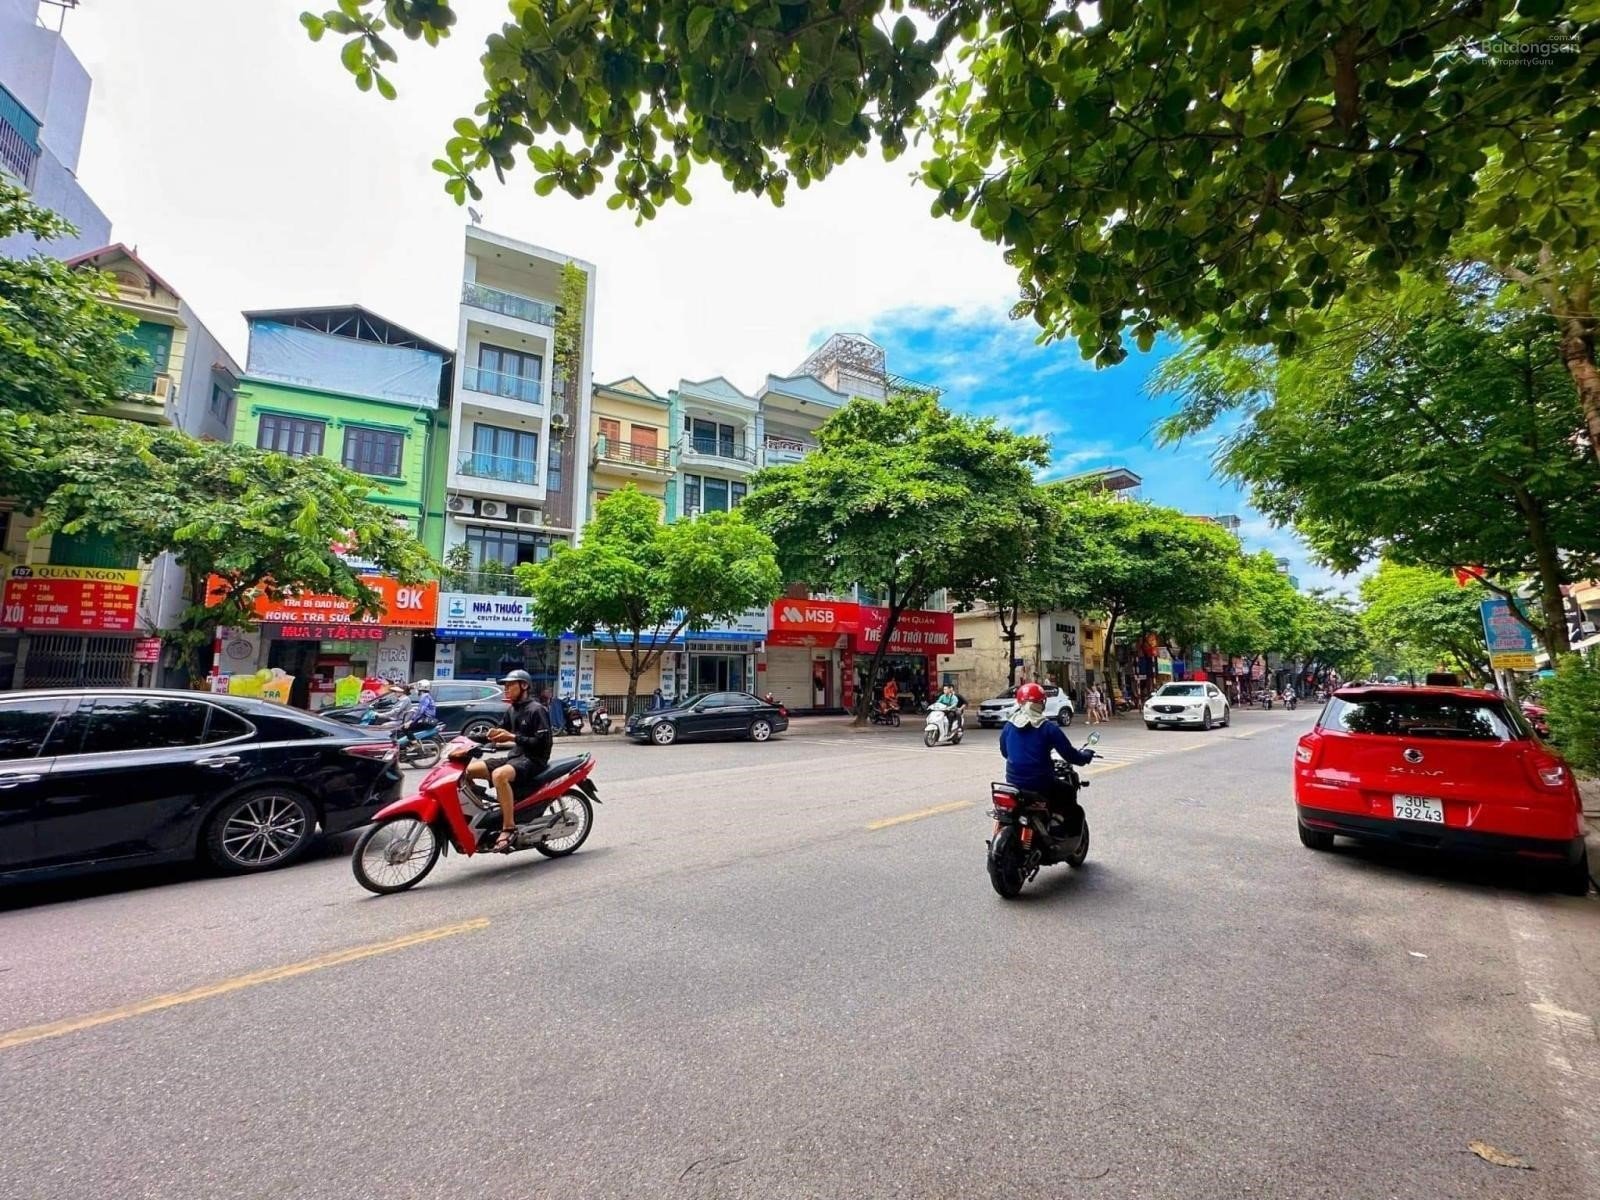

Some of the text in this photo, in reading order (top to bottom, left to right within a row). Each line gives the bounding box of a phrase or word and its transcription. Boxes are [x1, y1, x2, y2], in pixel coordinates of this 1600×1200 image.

[85, 569, 126, 581] NGON
[396, 588, 425, 609] 9K
[4, 602, 24, 622] XÔI
[472, 600, 492, 613] NHÀ
[494, 600, 523, 615] THUỐC
[805, 609, 834, 623] MSB
[314, 627, 322, 637] 2
[924, 631, 949, 645] TRANG
[1405, 795, 1431, 809] 30E
